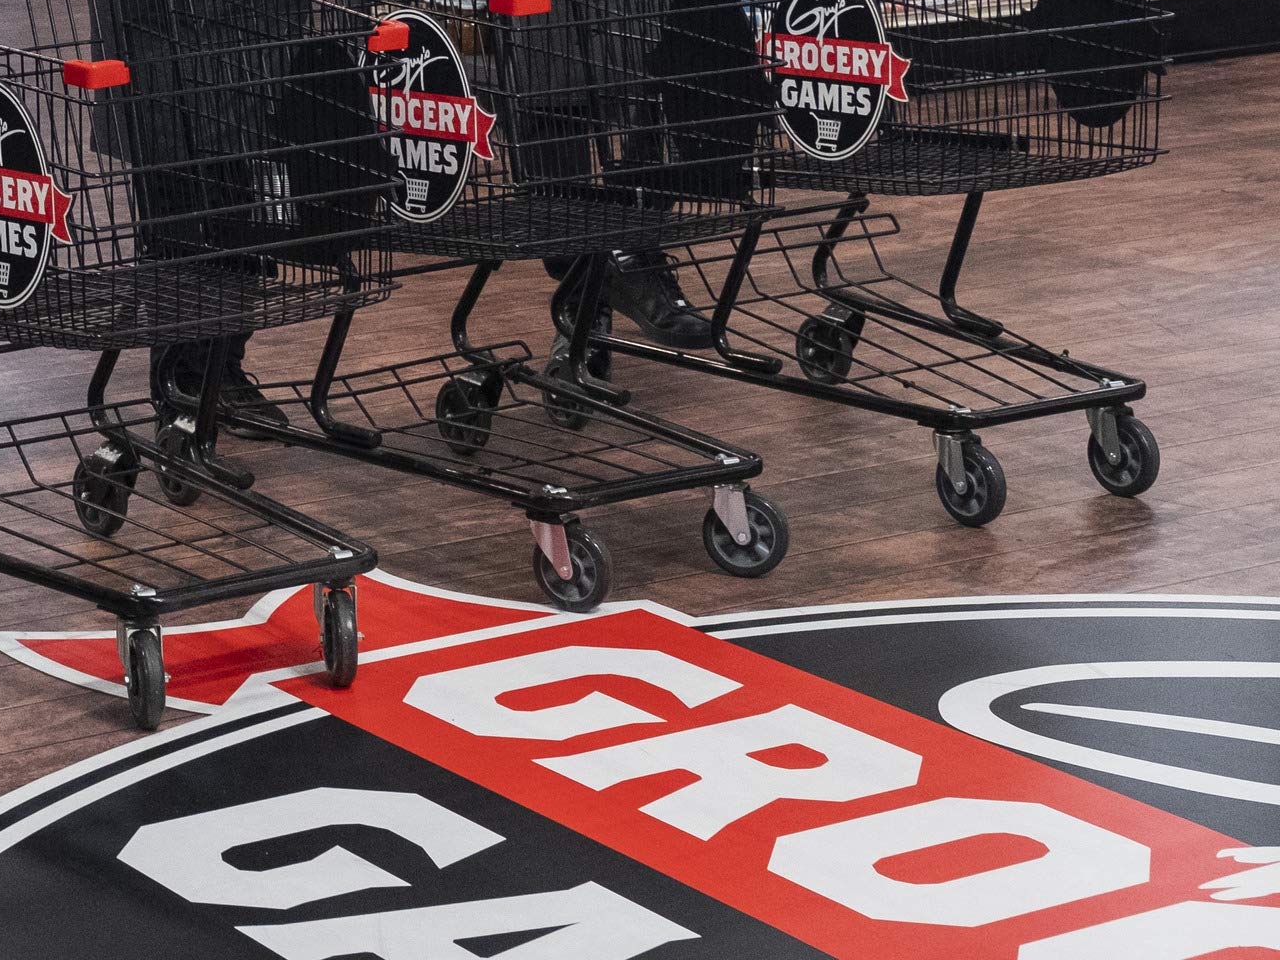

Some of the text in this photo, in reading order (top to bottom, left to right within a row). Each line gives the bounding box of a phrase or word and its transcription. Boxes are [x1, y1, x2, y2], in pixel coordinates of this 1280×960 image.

[766, 40, 887, 78] GROCERY
[371, 93, 472, 135] ROCERY
[781, 79, 871, 116] GAMES
[390, 137, 458, 175] AMES
